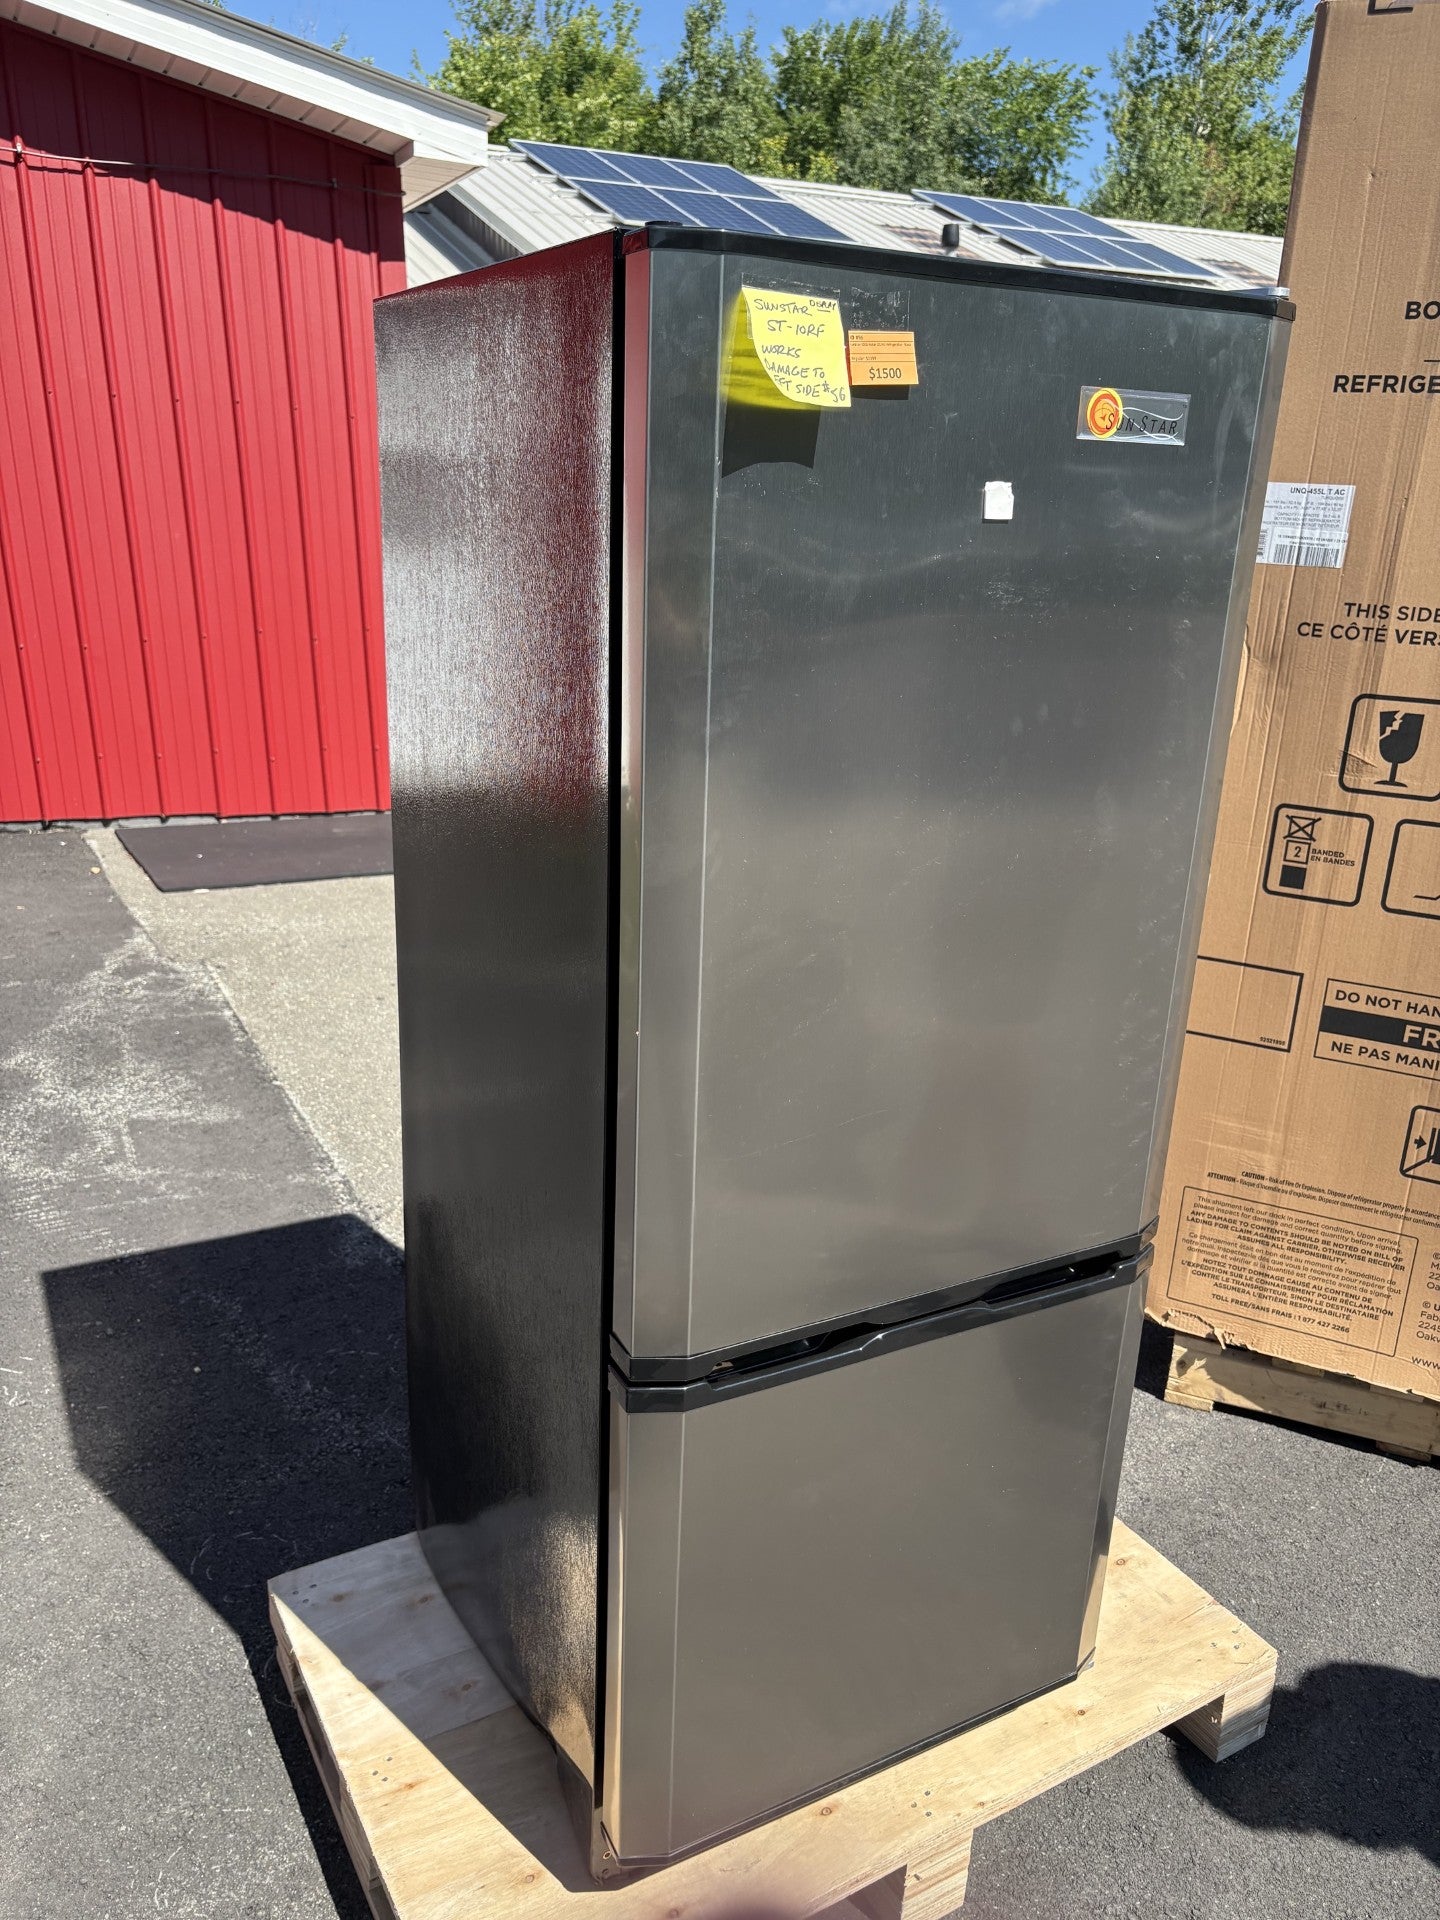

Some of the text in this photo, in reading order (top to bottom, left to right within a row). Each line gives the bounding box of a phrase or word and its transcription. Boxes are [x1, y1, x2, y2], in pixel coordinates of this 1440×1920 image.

[754, 298, 812, 316] SUNSTAR
[1405, 301, 1440, 320] BO
[762, 344, 802, 358] WORKS
[764, 358, 810, 378] DAMAGE
[869, 366, 901, 380] $1500
[796, 384, 820, 397] SIDE
[1333, 375, 1440, 393] REFRIGE
[1344, 602, 1390, 620] THIS
[1297, 622, 1440, 646] CE CÔTÉ VER
[1294, 846, 1301, 858] 2
[1312, 849, 1344, 858] BANDED
[1323, 857, 1355, 867] BANDES
[1335, 990, 1360, 1003] DO
[1365, 995, 1402, 1010] NOT
[1403, 1024, 1440, 1049] FR
[1331, 1041, 1440, 1071] NE PAS MANI
[1207, 1171, 1236, 1182] ATTENTION
[1241, 1170, 1264, 1181] CAUTION
[1211, 1292, 1229, 1302] TOLL
